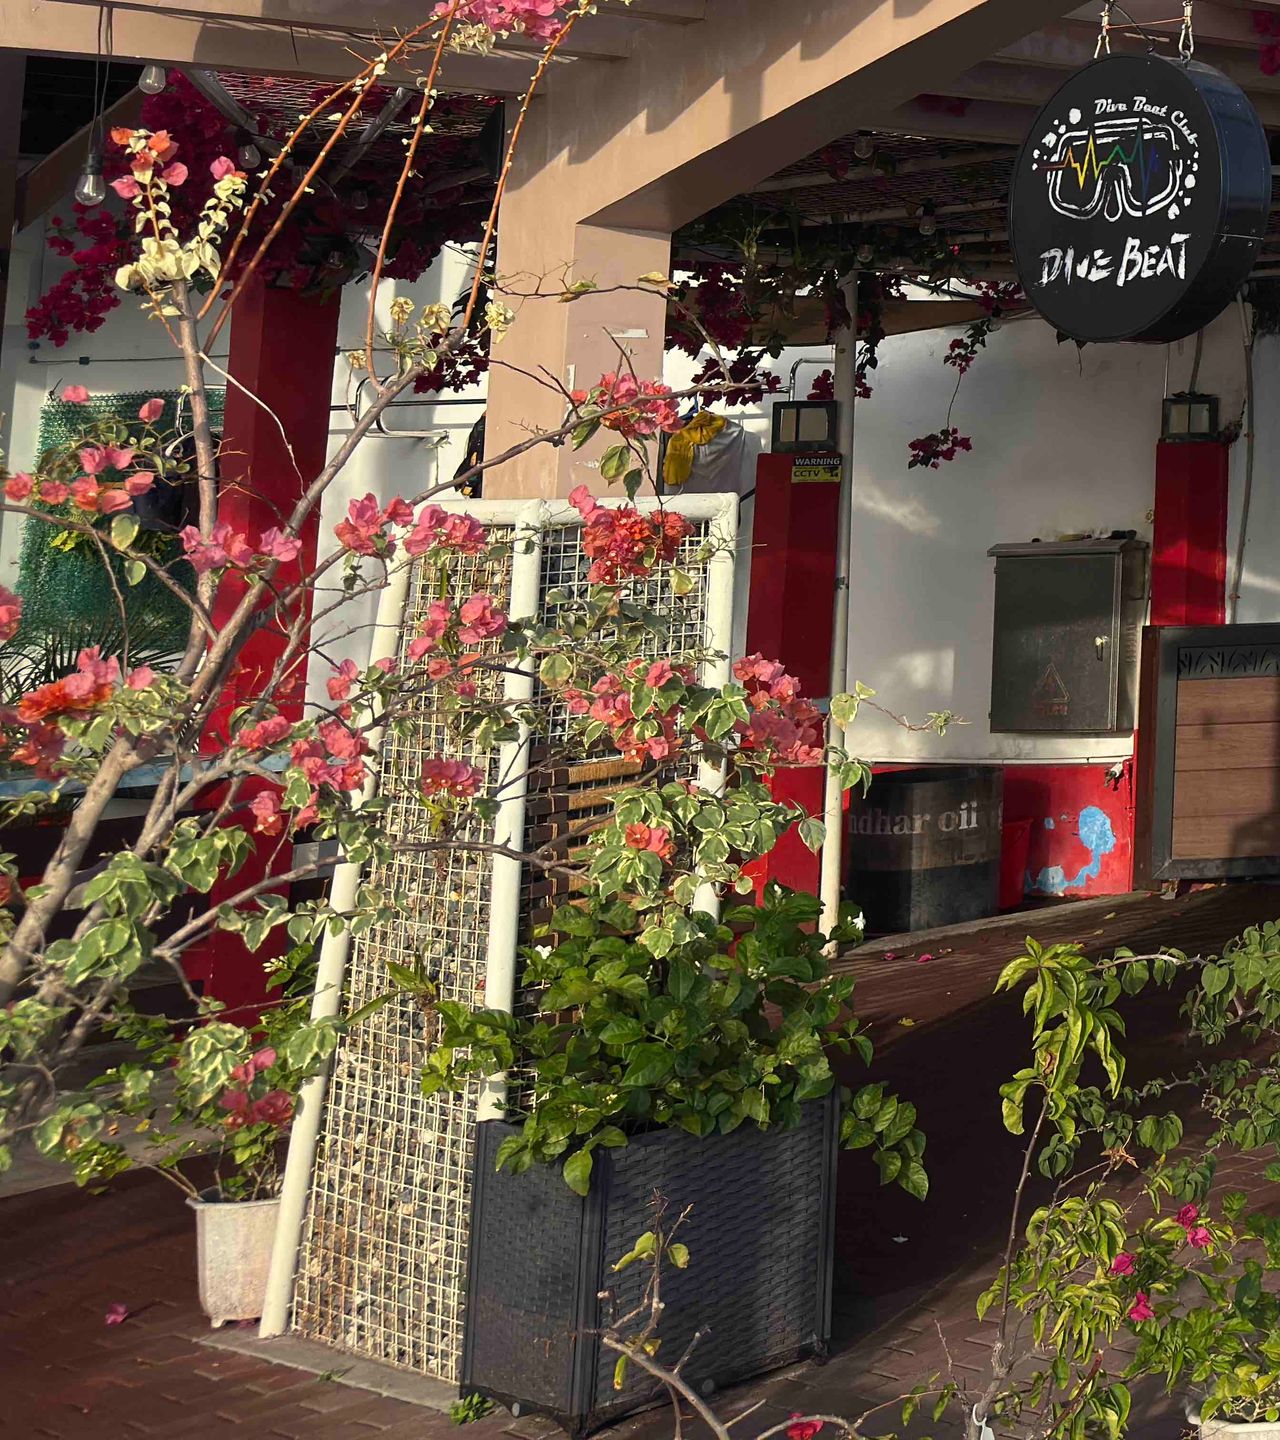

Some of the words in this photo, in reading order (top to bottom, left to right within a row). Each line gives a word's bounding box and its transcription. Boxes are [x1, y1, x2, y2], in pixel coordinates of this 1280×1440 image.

[1170, 110, 1199, 147] Club
[1116, 231, 1192, 288] BEAT
[795, 457, 840, 465] WARNING
